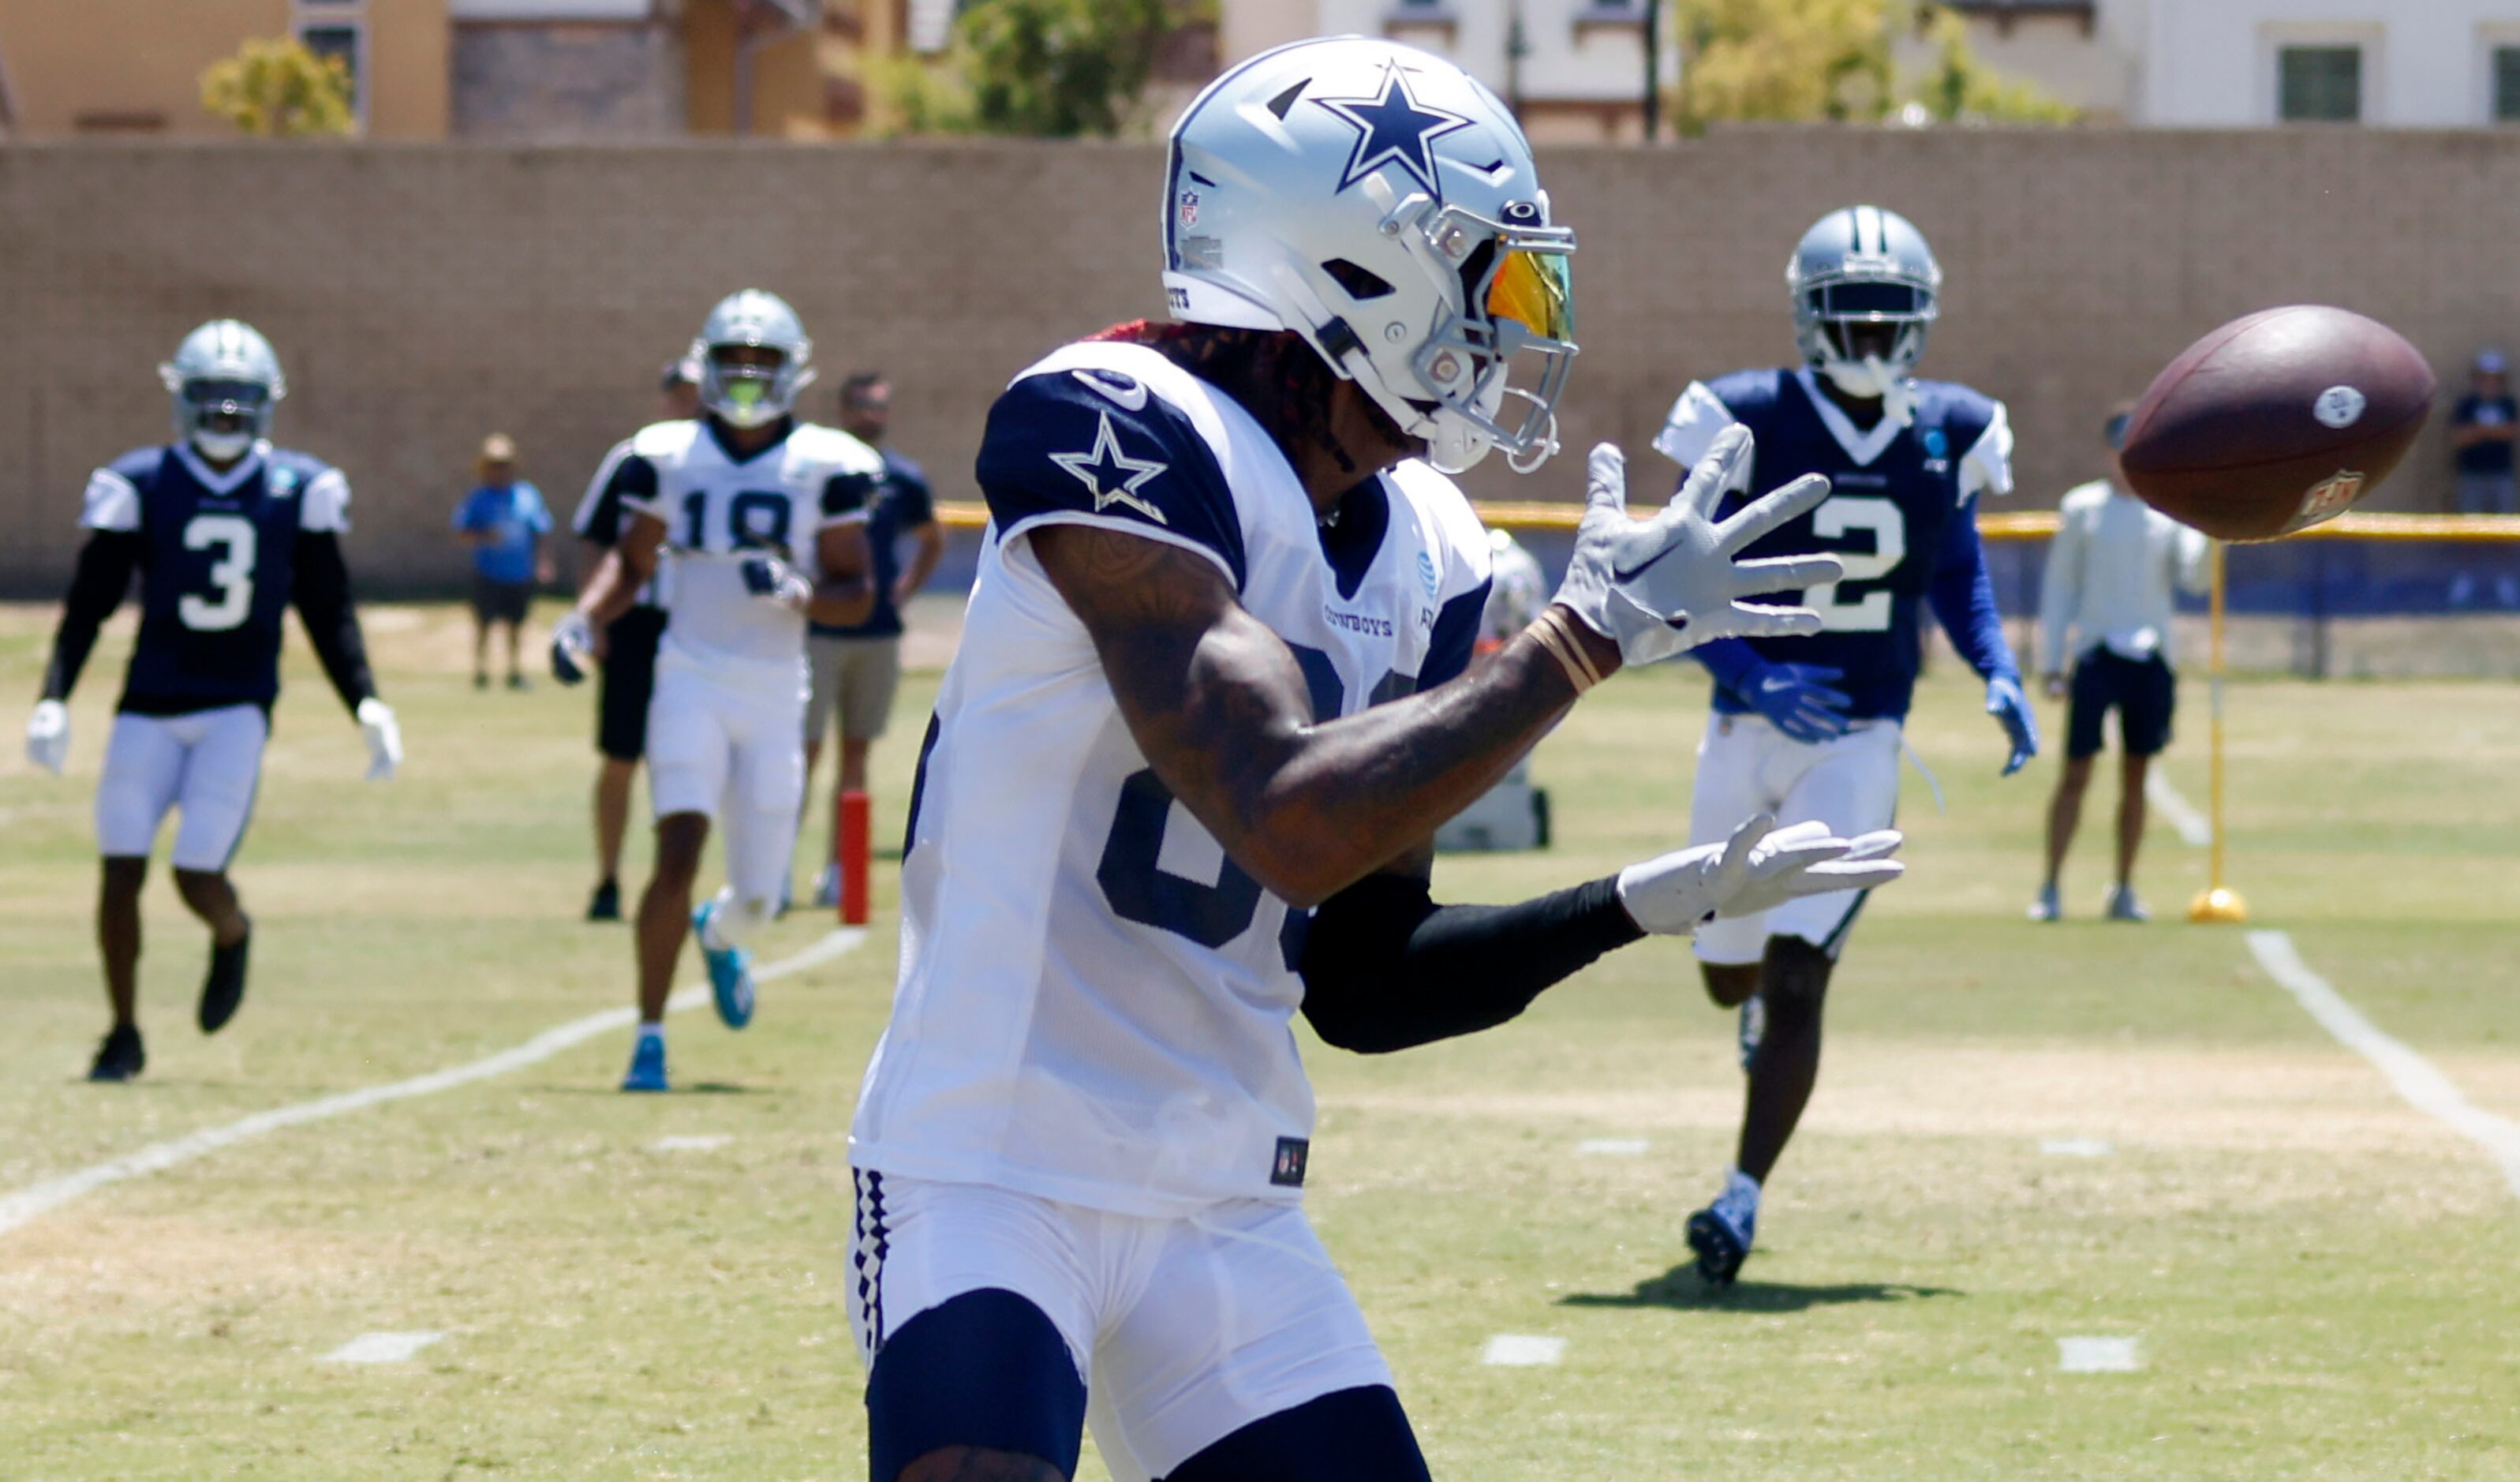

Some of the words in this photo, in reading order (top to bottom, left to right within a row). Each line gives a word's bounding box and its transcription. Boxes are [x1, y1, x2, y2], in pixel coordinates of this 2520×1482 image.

[683, 490, 791, 551] 18
[1802, 497, 1906, 631] 2
[178, 514, 257, 631] 3
[1324, 604, 1393, 637] COWBOYS
